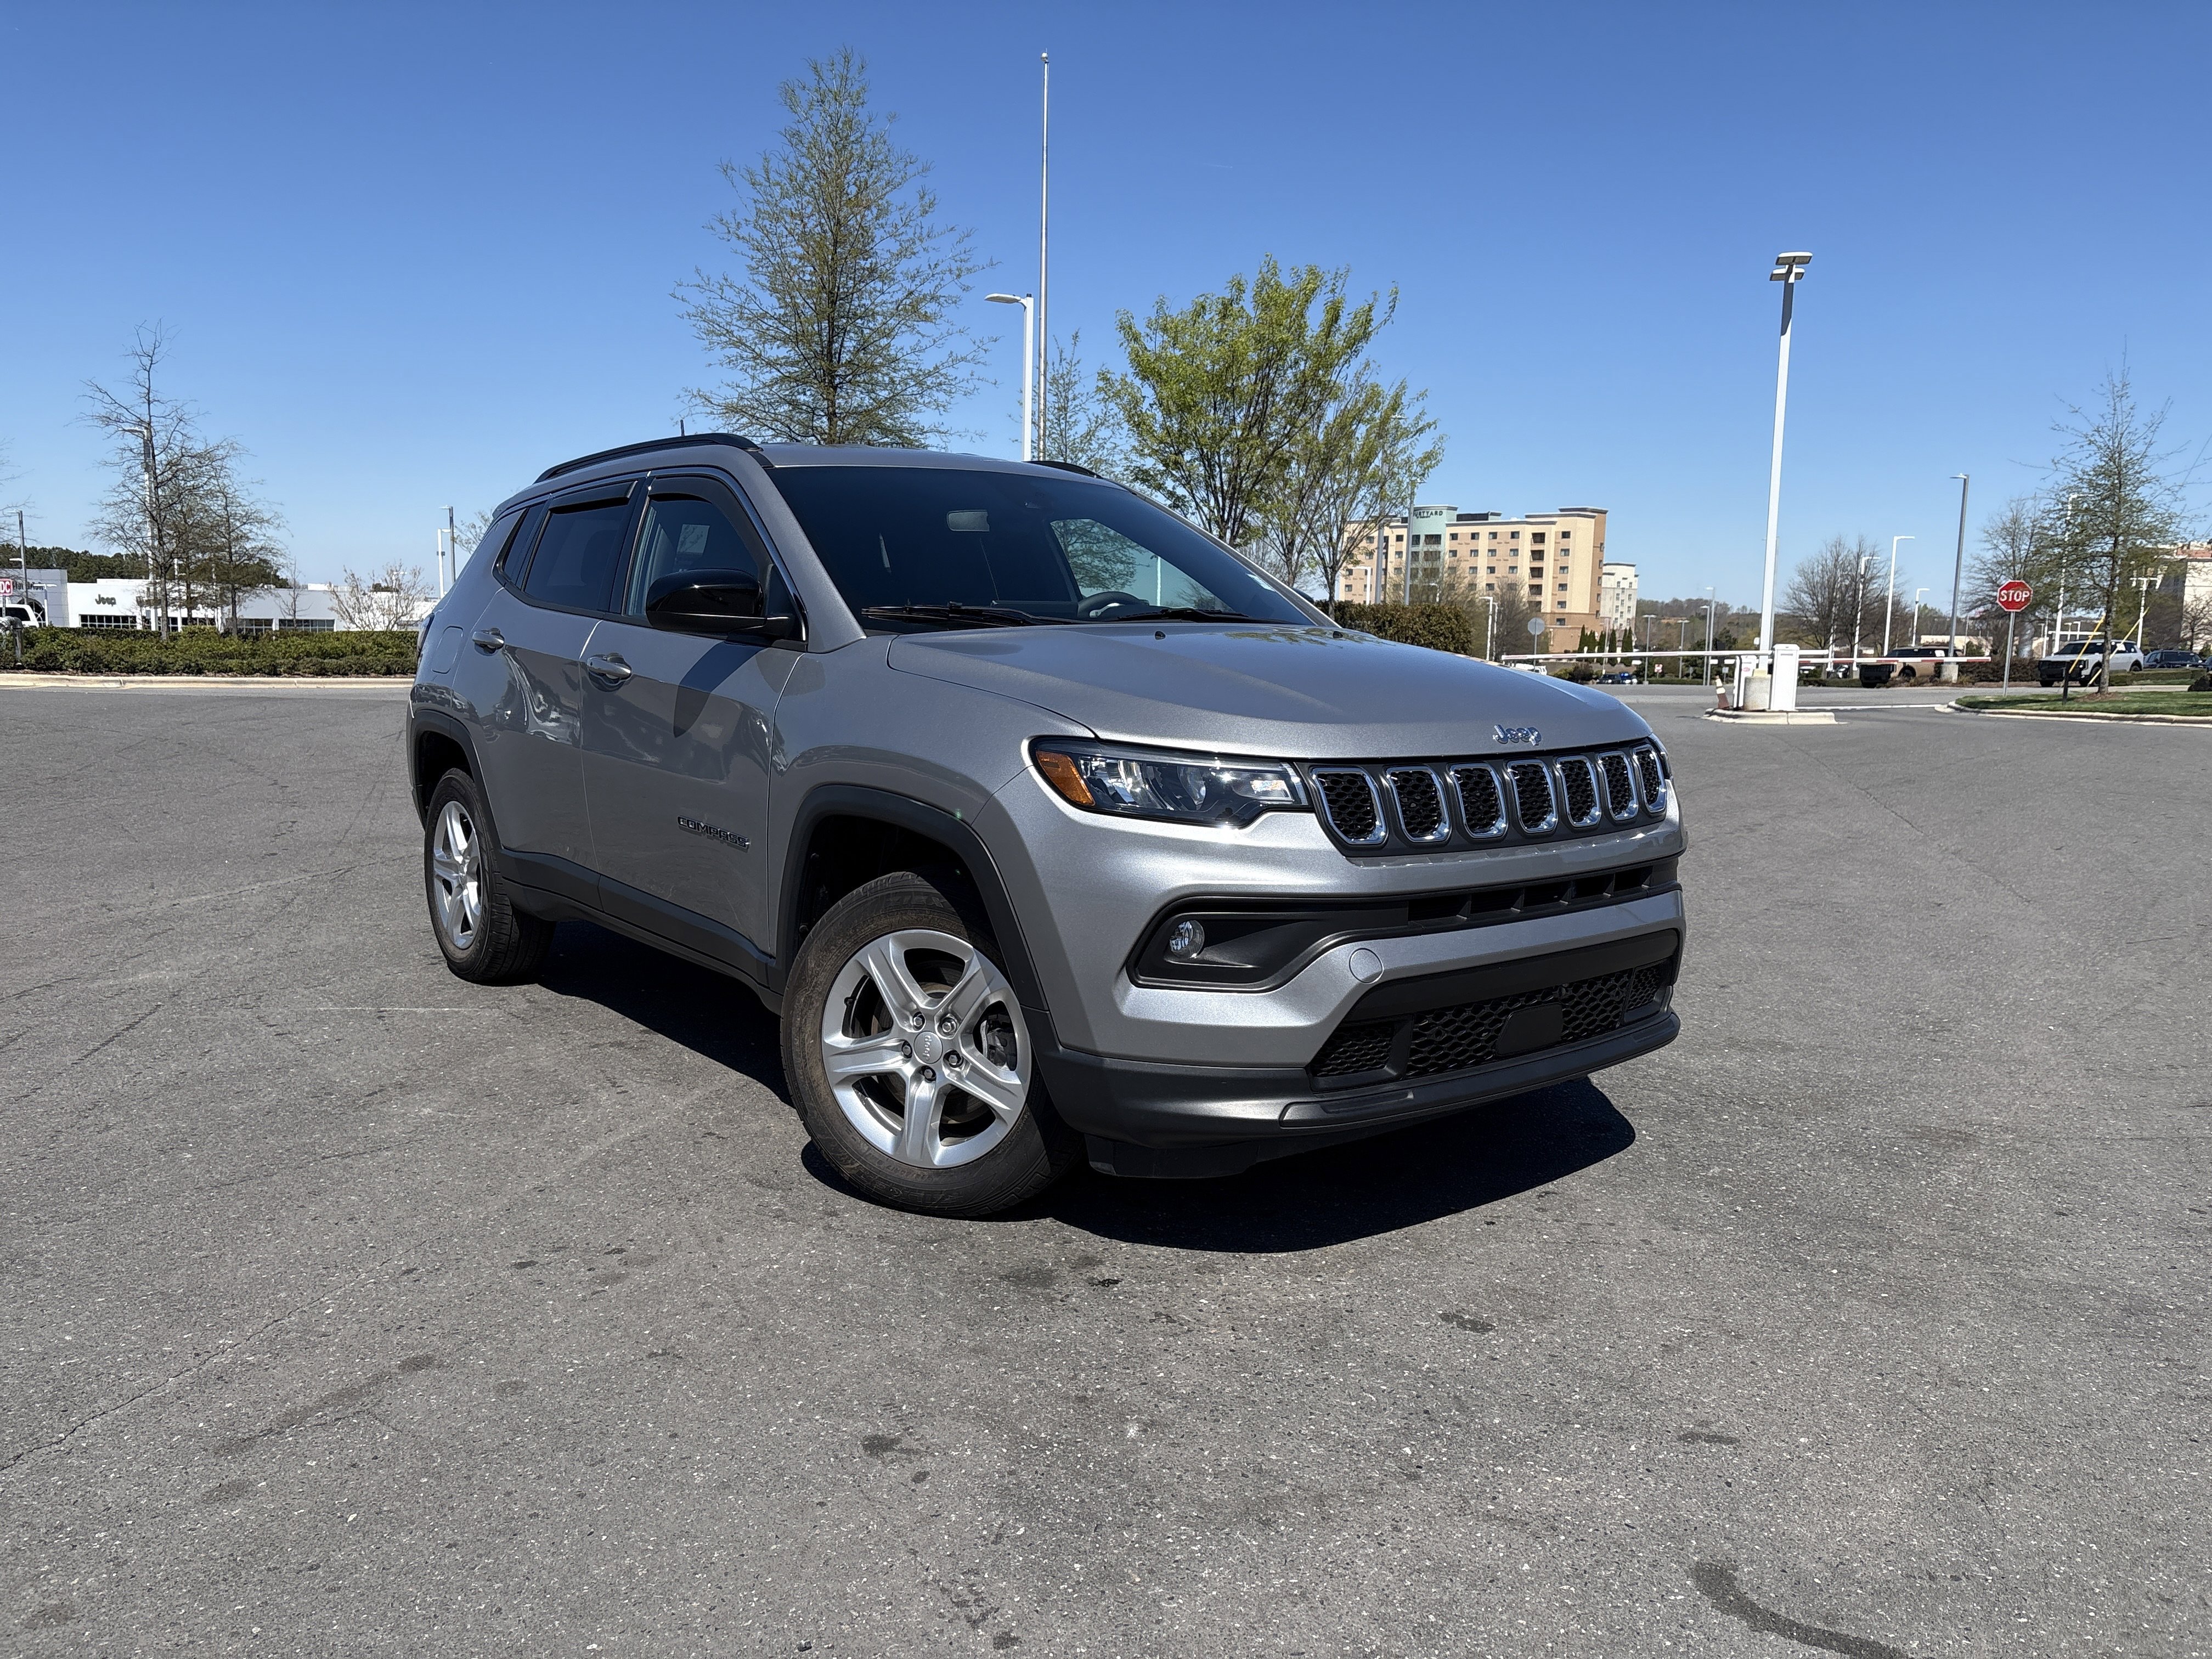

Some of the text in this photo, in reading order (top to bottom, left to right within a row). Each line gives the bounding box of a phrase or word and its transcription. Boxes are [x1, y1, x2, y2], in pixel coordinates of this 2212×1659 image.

[95, 594, 117, 607] Jeep
[2000, 590, 2030, 602] STOP
[1492, 724, 1542, 746] Jeep
[678, 816, 750, 848] COMPASS
[923, 1035, 932, 1061] Jeep
